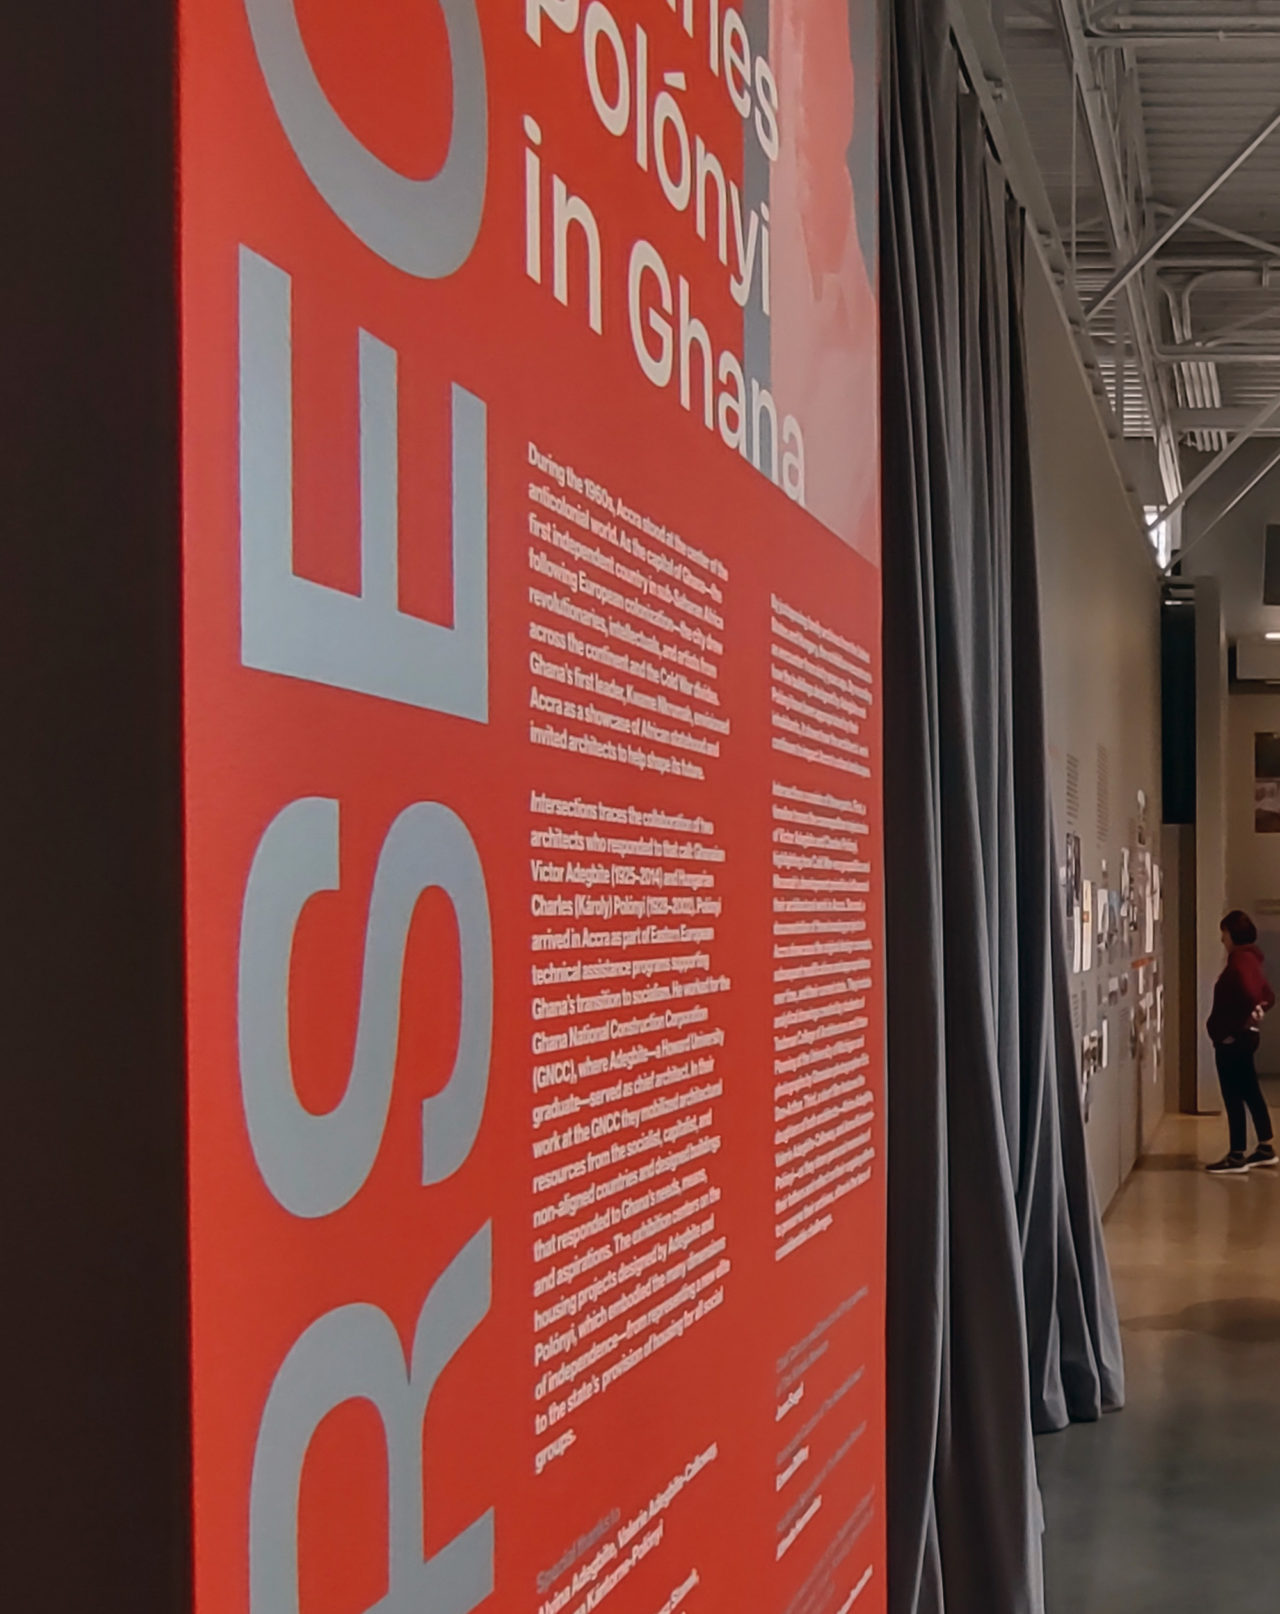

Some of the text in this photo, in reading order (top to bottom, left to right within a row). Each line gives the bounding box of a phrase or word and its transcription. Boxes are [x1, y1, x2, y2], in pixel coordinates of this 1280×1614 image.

[523, 114, 805, 507] in Ghana
[528, 440, 565, 488] During
[566, 464, 583, 495] the
[528, 479, 589, 531] anticolonial
[529, 510, 551, 544] first
[529, 545, 577, 594] following
[529, 619, 566, 650] across
[567, 630, 584, 657] the
[529, 649, 573, 686] Ghana's
[530, 685, 562, 716] Accra
[563, 699, 575, 719] as
[576, 703, 584, 721] a
[530, 719, 567, 750] invited
[530, 789, 597, 820] Intersections
[531, 827, 585, 851] architects
[531, 859, 564, 882] Victor
[531, 893, 573, 916] Charles
[531, 928, 571, 951] arrived
[571, 928, 580, 949] in
[531, 960, 581, 986] technical
[532, 994, 575, 1020] Ghana's
[532, 1030, 567, 1055] Ghana
[533, 1057, 577, 1094] (GNCC),
[532, 1127, 561, 1159] work
[562, 1124, 573, 1149] at
[533, 1158, 586, 1195] resources
[533, 1231, 556, 1264] that
[533, 1265, 555, 1299] and
[534, 1292, 576, 1333] housing
[534, 1322, 578, 1368] Polónyi,
[535, 1372, 547, 1402] of
[535, 1411, 547, 1437] to
[548, 1398, 566, 1428] the
[535, 1426, 576, 1476] groups.
